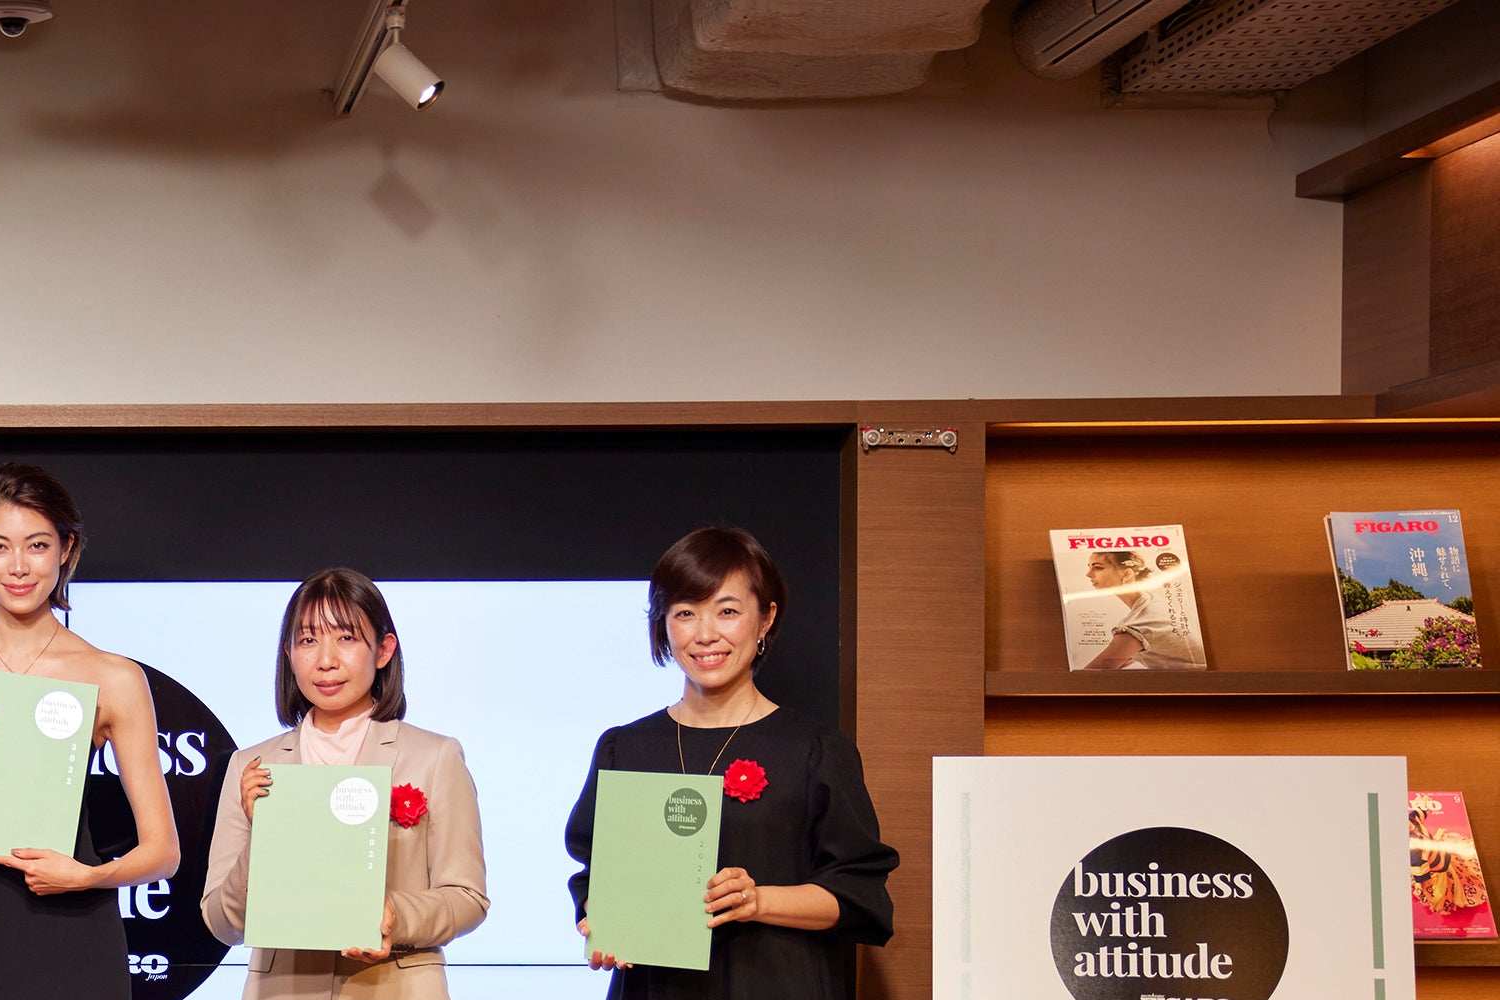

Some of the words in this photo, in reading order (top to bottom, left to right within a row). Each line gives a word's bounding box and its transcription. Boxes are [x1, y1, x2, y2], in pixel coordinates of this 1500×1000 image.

[1448, 515, 1459, 523] 12
[1354, 520, 1439, 534] FIGARO
[1068, 535, 1170, 549] FIGARO
[1409, 547, 1428, 582] 沖縄。
[1448, 546, 1461, 572] 物語に
[668, 795, 703, 805] business
[668, 804, 686, 814] with
[667, 813, 697, 823] attitude
[1074, 861, 1254, 899] business
[1072, 901, 1168, 938] with
[1073, 942, 1234, 980] attitude
